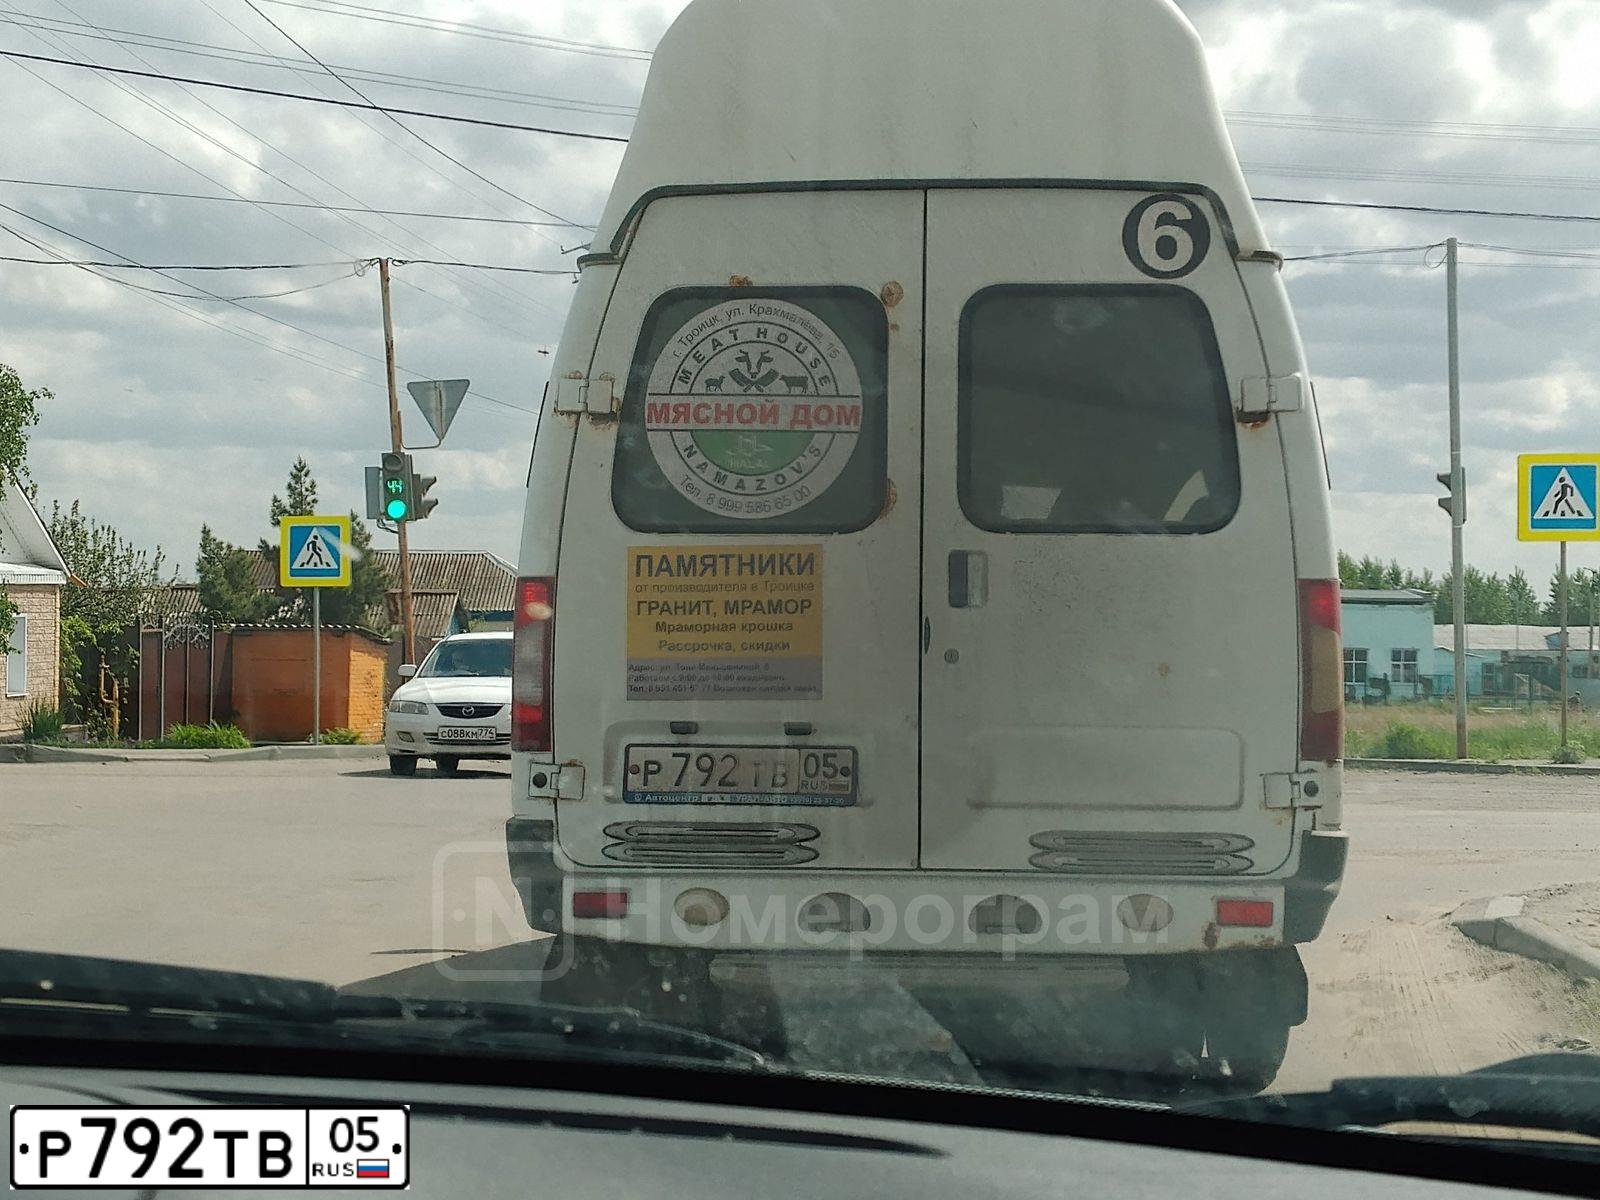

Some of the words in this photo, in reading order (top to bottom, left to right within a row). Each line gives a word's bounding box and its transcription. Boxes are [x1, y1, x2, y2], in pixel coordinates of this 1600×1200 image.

[1138, 200, 1194, 272] 6
[726, 307, 744, 321] ул.
[677, 328, 739, 385] MEAT
[756, 327, 831, 386] HOUSE
[647, 398, 780, 425] МЯСНОЙ
[790, 404, 860, 428] ДОМ
[683, 444, 822, 491] NAMAZOV'S
[793, 485, 811, 502] 00
[635, 552, 815, 577] ПАМЯТНИКИ
[635, 584, 649, 593] от
[652, 583, 747, 594] производителя
[751, 583, 758, 591] в
[636, 600, 717, 618] ГРАНИТ,
[724, 599, 812, 615] МРАМОР
[655, 621, 736, 634] Мраморная
[741, 621, 793, 633] крошка
[659, 639, 735, 653] Рассрочка,
[741, 641, 790, 652] скидки
[804, 753, 838, 778] 05
